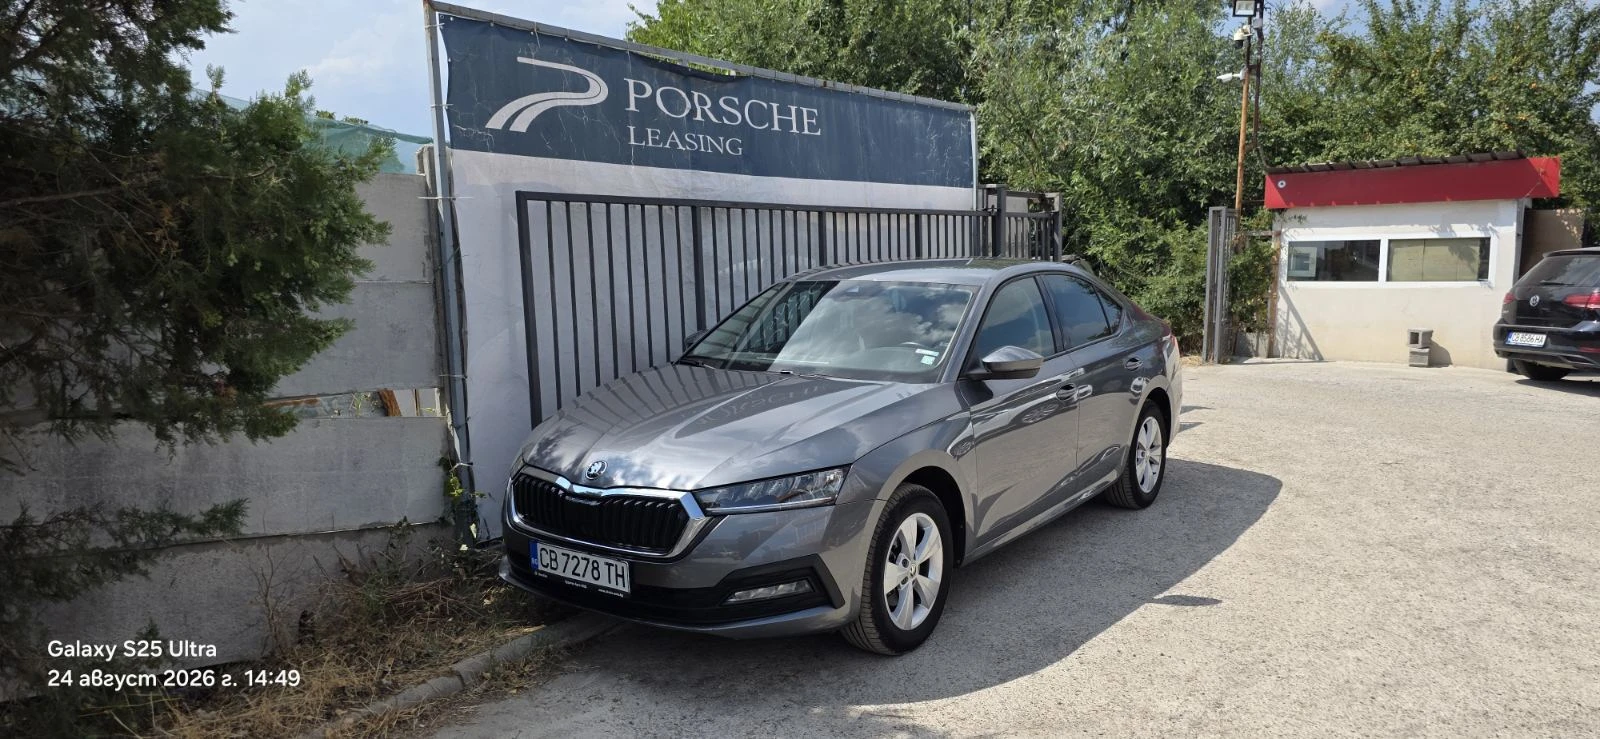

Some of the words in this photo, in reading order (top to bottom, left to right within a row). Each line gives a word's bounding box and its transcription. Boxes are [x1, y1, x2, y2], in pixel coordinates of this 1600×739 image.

[623, 77, 822, 136] PORSCHE
[627, 125, 743, 156] LEASING
[540, 547, 559, 570] CB
[561, 553, 600, 581] 7278
[604, 562, 625, 588] TH
